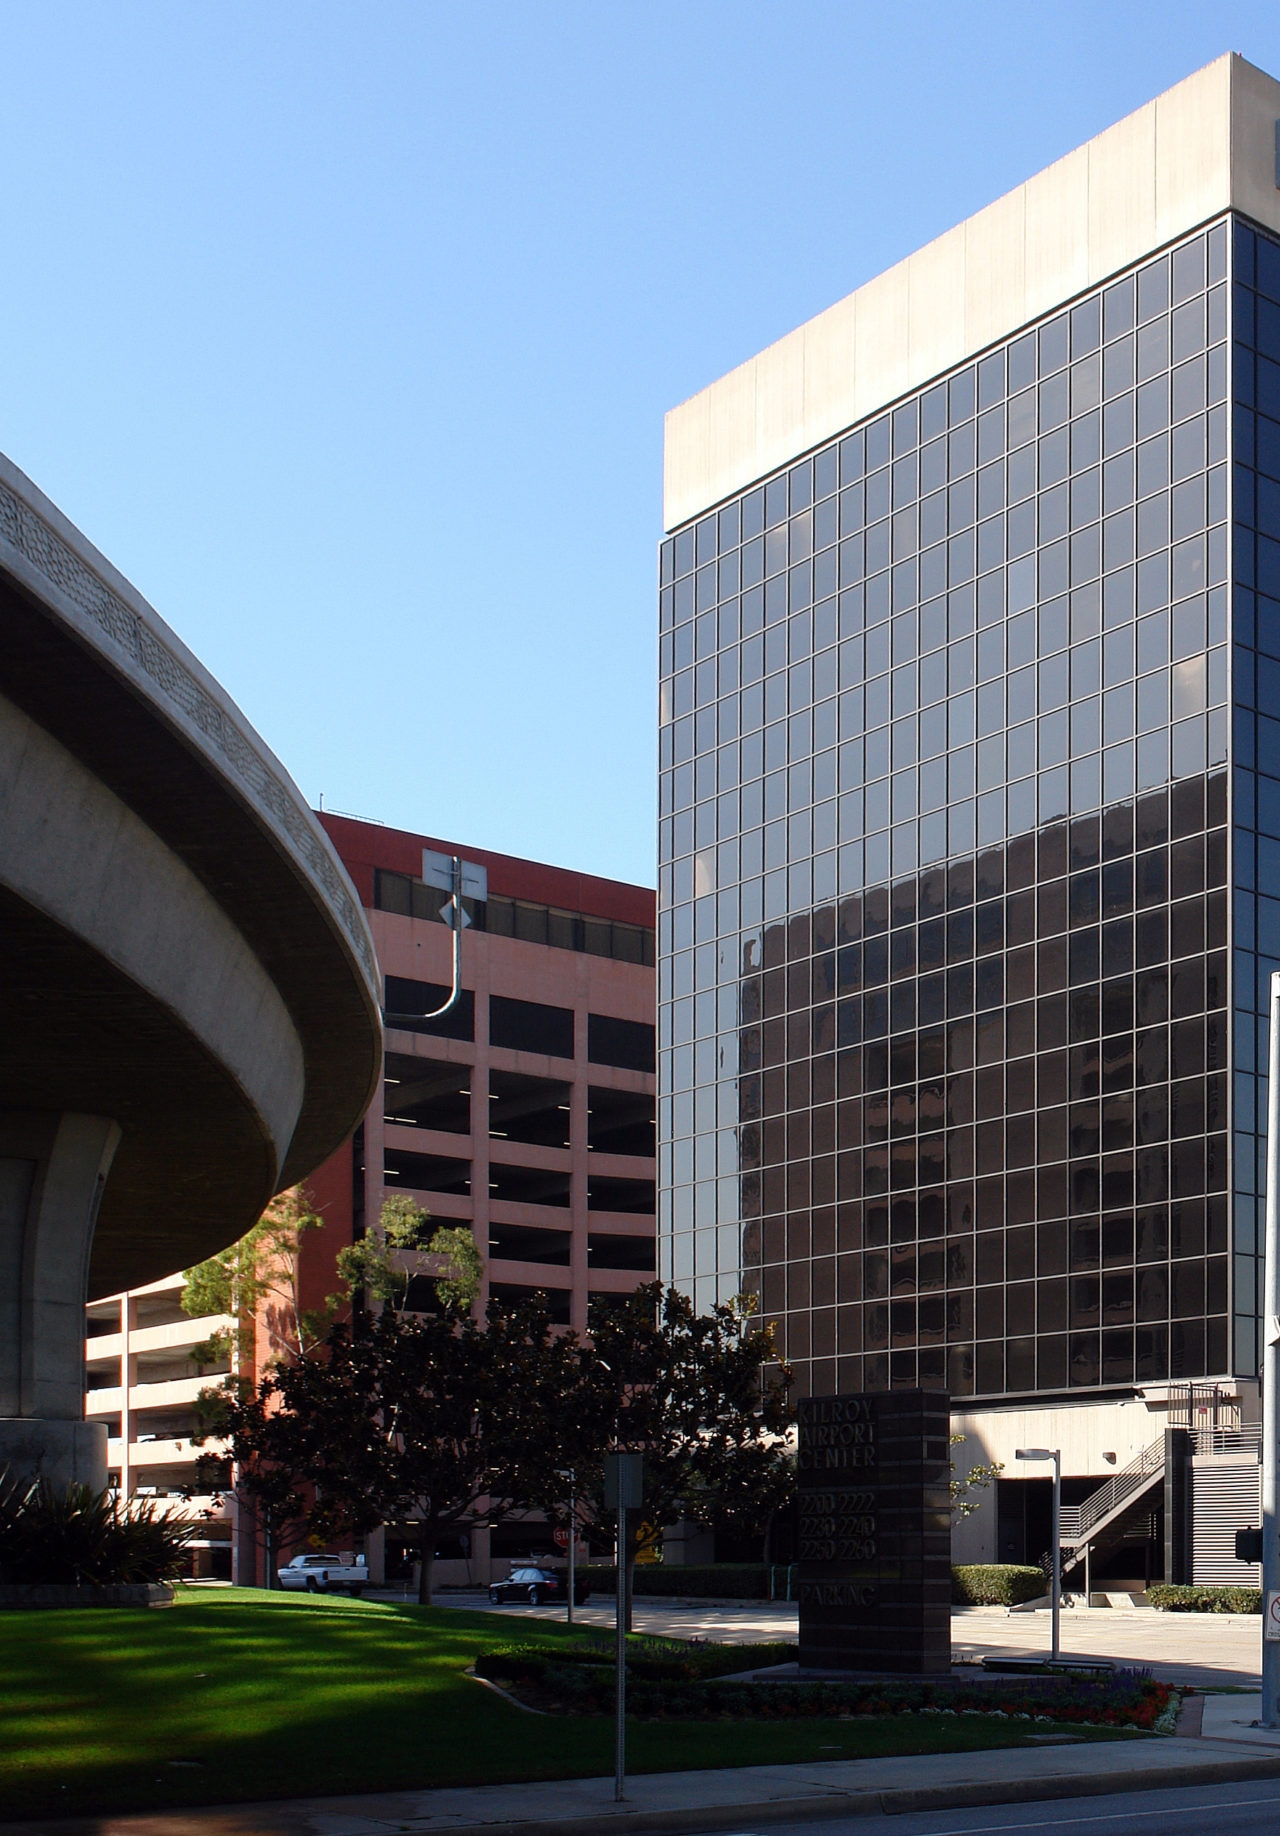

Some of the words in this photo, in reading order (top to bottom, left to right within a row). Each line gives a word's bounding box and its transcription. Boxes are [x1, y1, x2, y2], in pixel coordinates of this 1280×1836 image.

[800, 1398, 873, 1424] KILROY
[799, 1421, 876, 1447] AIRPORT
[799, 1444, 876, 1470] CENTER
[800, 1583, 875, 1608] PARKING
